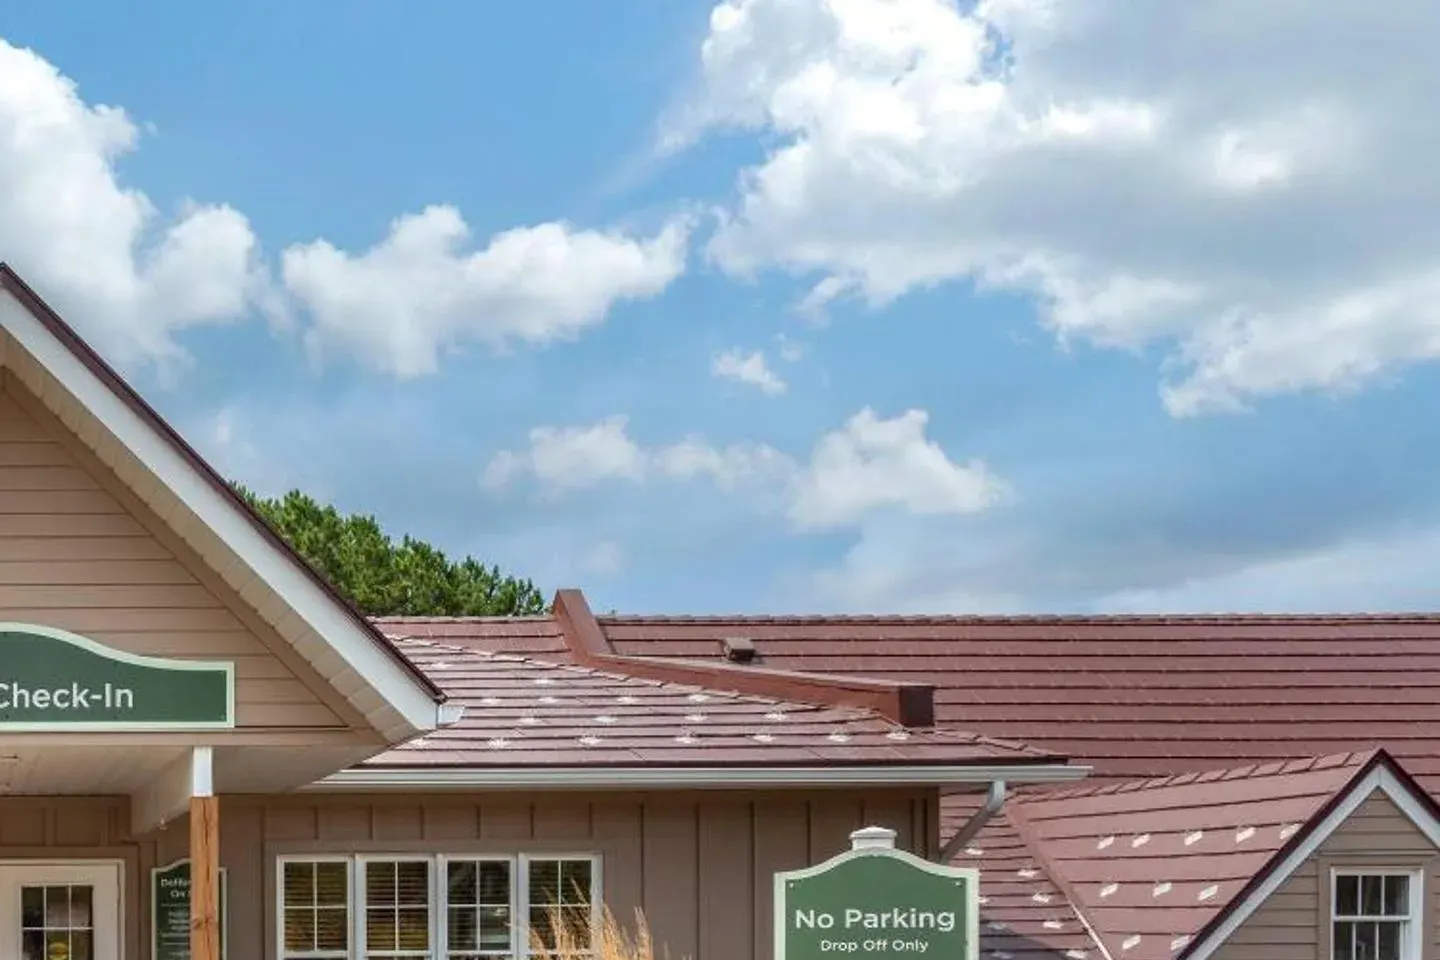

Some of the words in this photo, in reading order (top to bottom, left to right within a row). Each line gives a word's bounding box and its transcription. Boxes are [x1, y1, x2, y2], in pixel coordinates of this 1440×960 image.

[795, 908, 834, 929] No
[845, 908, 956, 932] Parking
[820, 940, 858, 953] Drop
[863, 939, 887, 951] Off
[892, 939, 929, 953] Only
